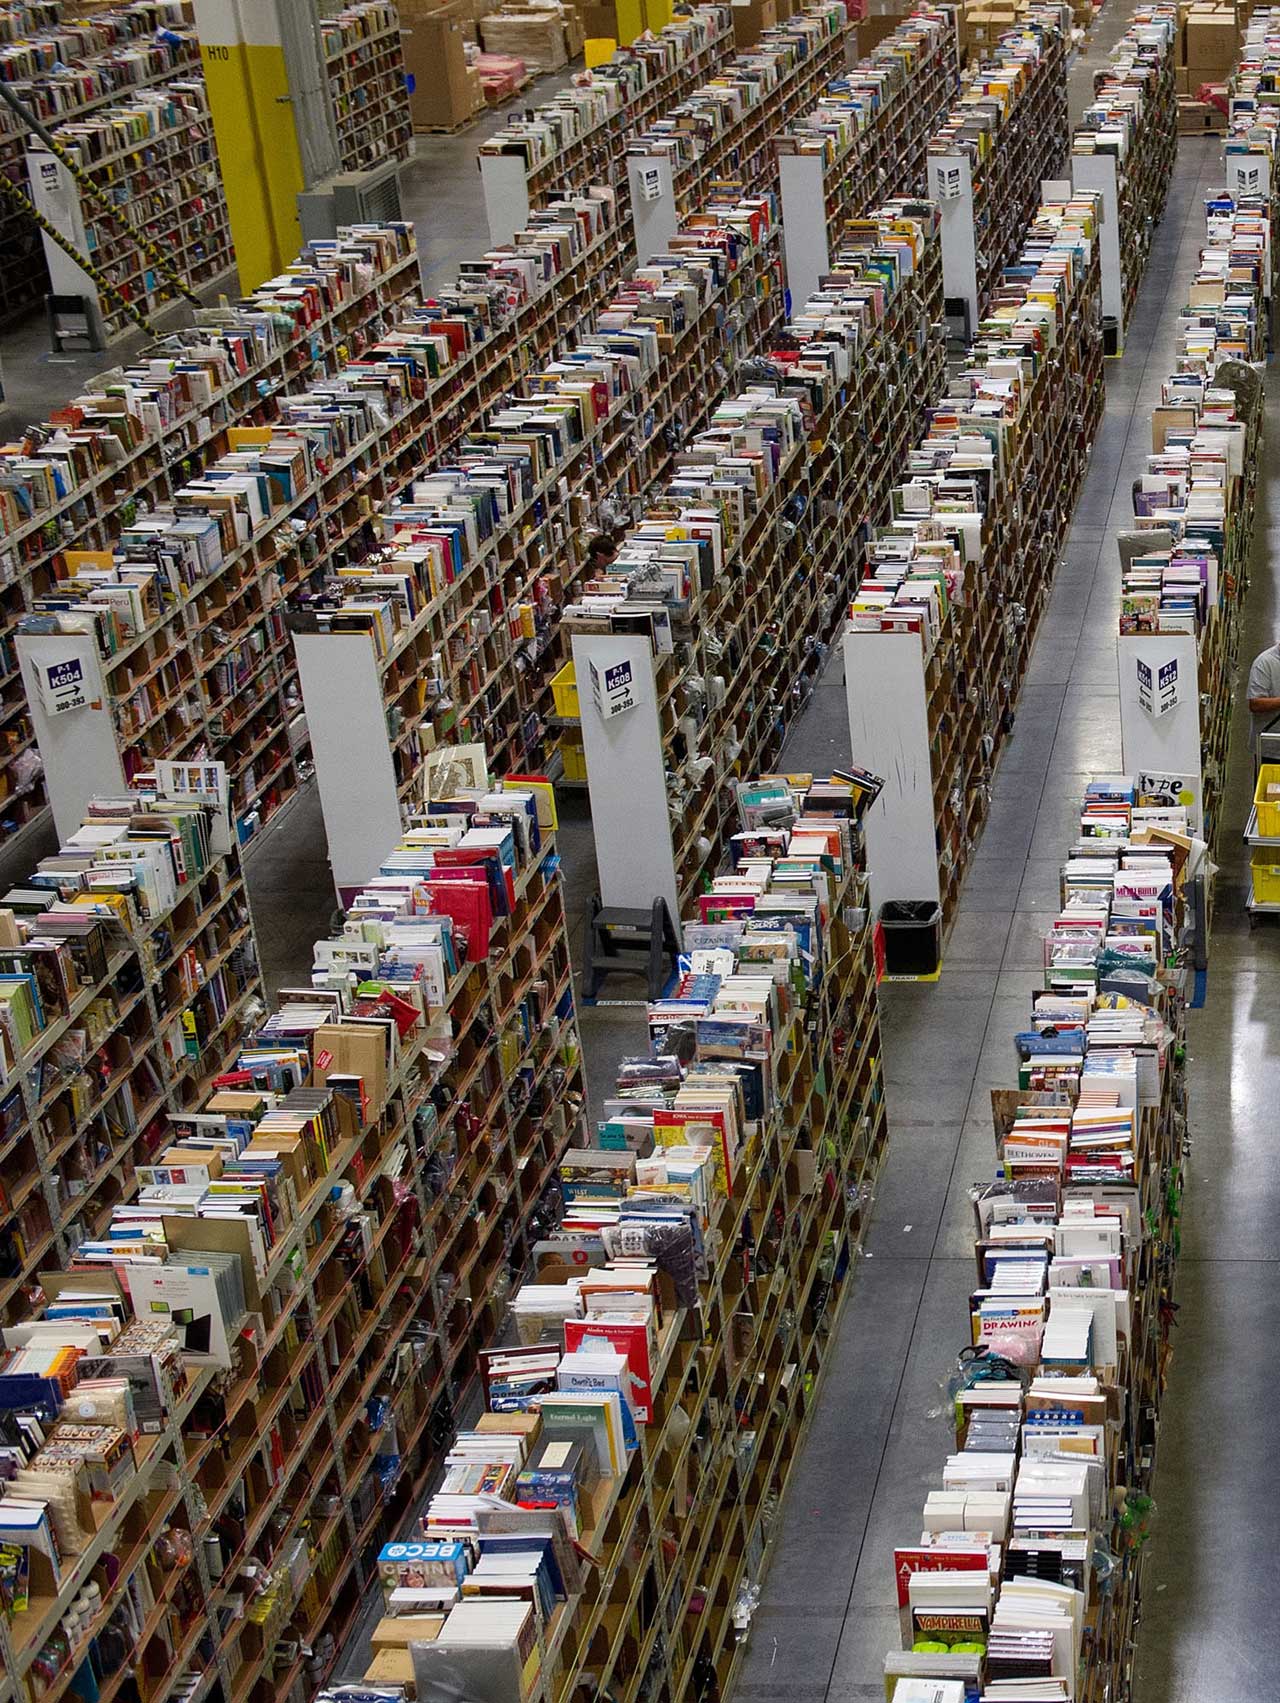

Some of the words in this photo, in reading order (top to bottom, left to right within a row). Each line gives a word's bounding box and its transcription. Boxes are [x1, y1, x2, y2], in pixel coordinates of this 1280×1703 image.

[207, 46, 229, 60] H10
[111, 598, 129, 606] Peru
[57, 664, 71, 674] P-1
[612, 665, 624, 676] P-1
[51, 670, 81, 688] K504
[608, 672, 631, 689] K508
[1159, 671, 1177, 688] K512
[56, 696, 86, 712] 300-393
[1140, 776, 1182, 795] type
[1008, 1150, 1055, 1158] BEETHOVEN
[388, 1544, 457, 1557] BECO
[385, 1563, 453, 1575] GEMINI
[916, 1615, 983, 1632] VAMPIRELLA
